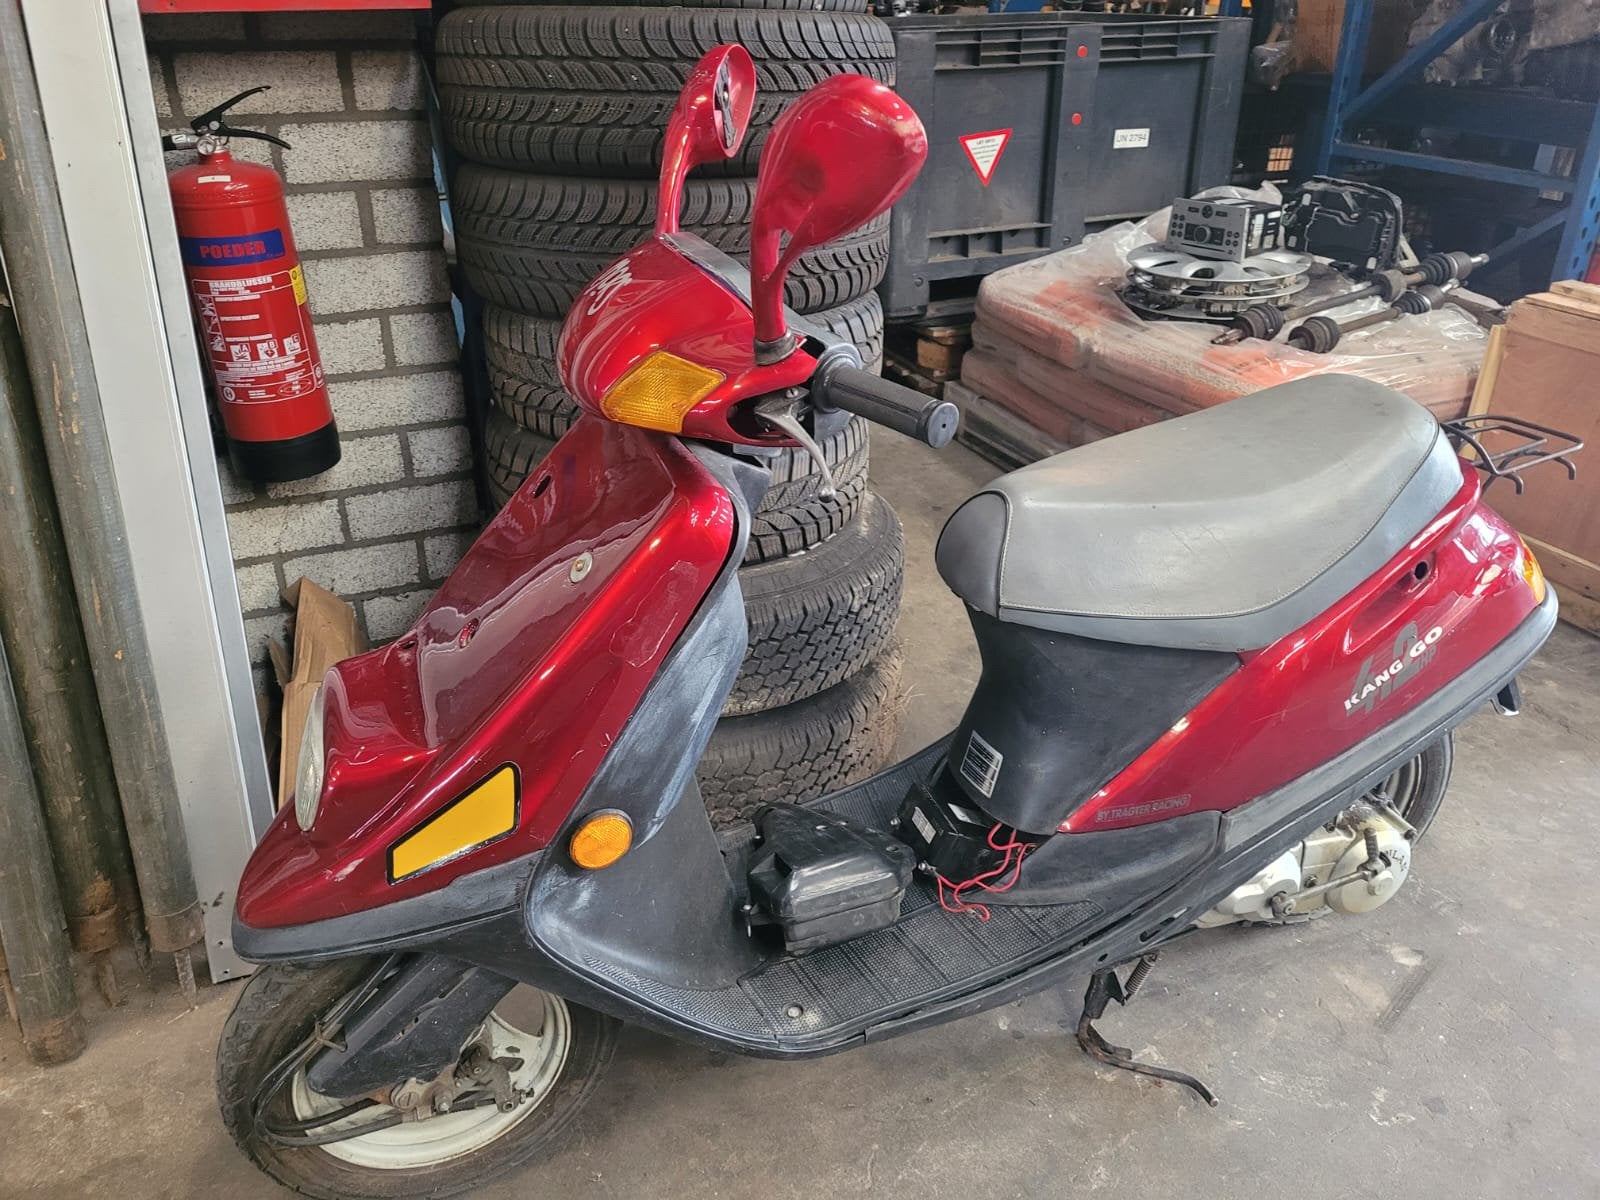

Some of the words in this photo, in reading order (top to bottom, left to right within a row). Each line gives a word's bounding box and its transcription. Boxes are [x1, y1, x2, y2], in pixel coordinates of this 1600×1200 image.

[199, 240, 267, 259] POEDER
[1344, 659, 1404, 711] KANG
[1409, 626, 1443, 658] GO
